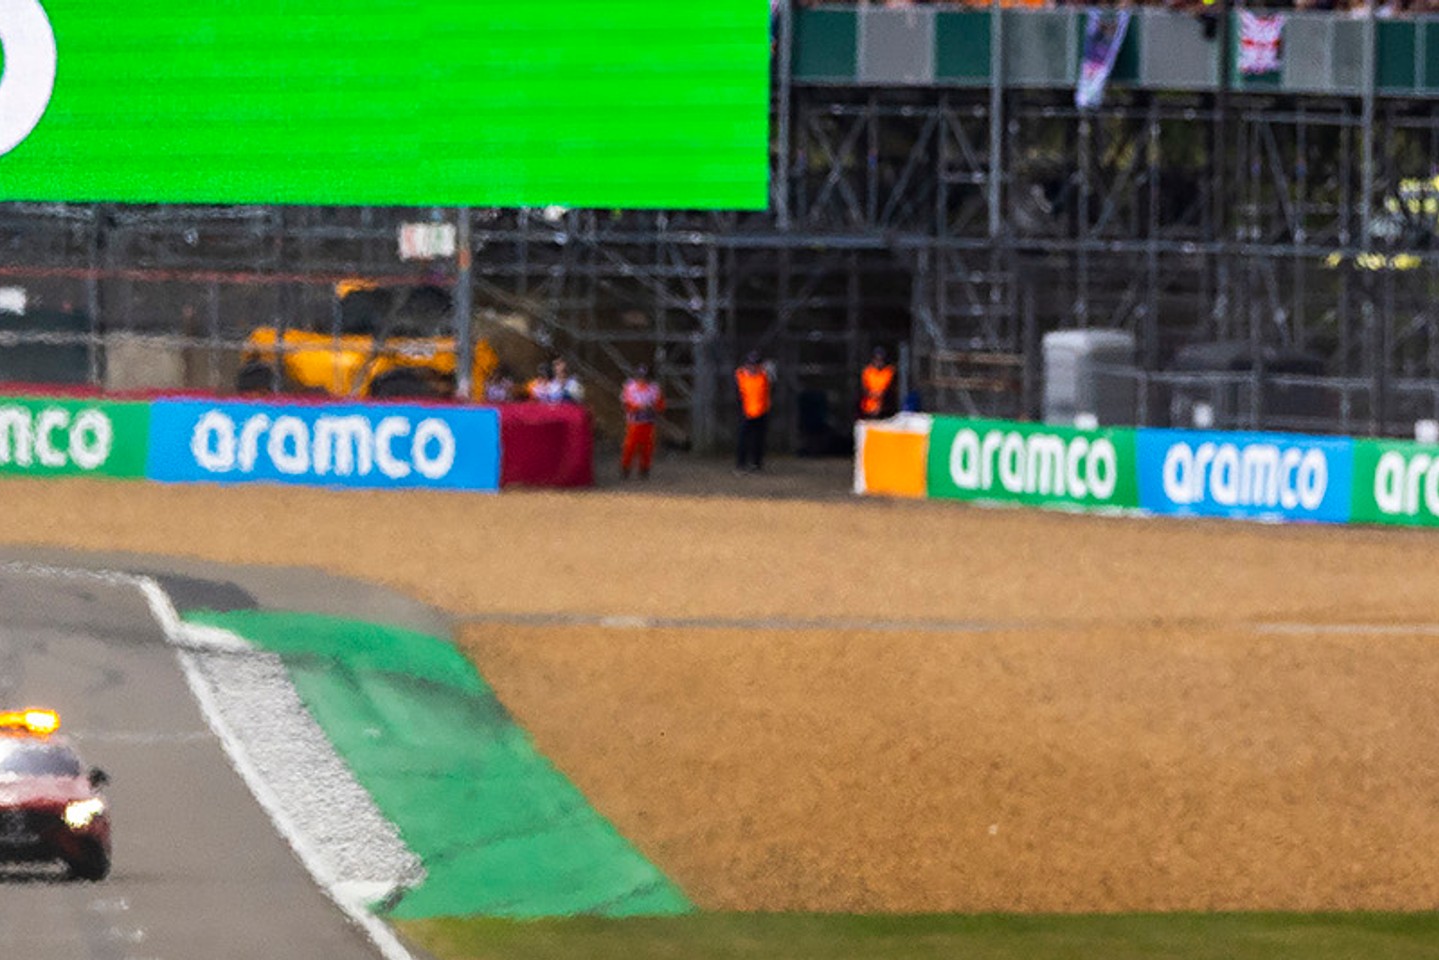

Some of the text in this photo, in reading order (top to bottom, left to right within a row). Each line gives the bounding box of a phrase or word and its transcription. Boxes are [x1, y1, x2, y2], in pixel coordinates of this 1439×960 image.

[191, 409, 455, 479] aramco
[949, 428, 1117, 499] aramco
[1163, 442, 1328, 510] aramco
